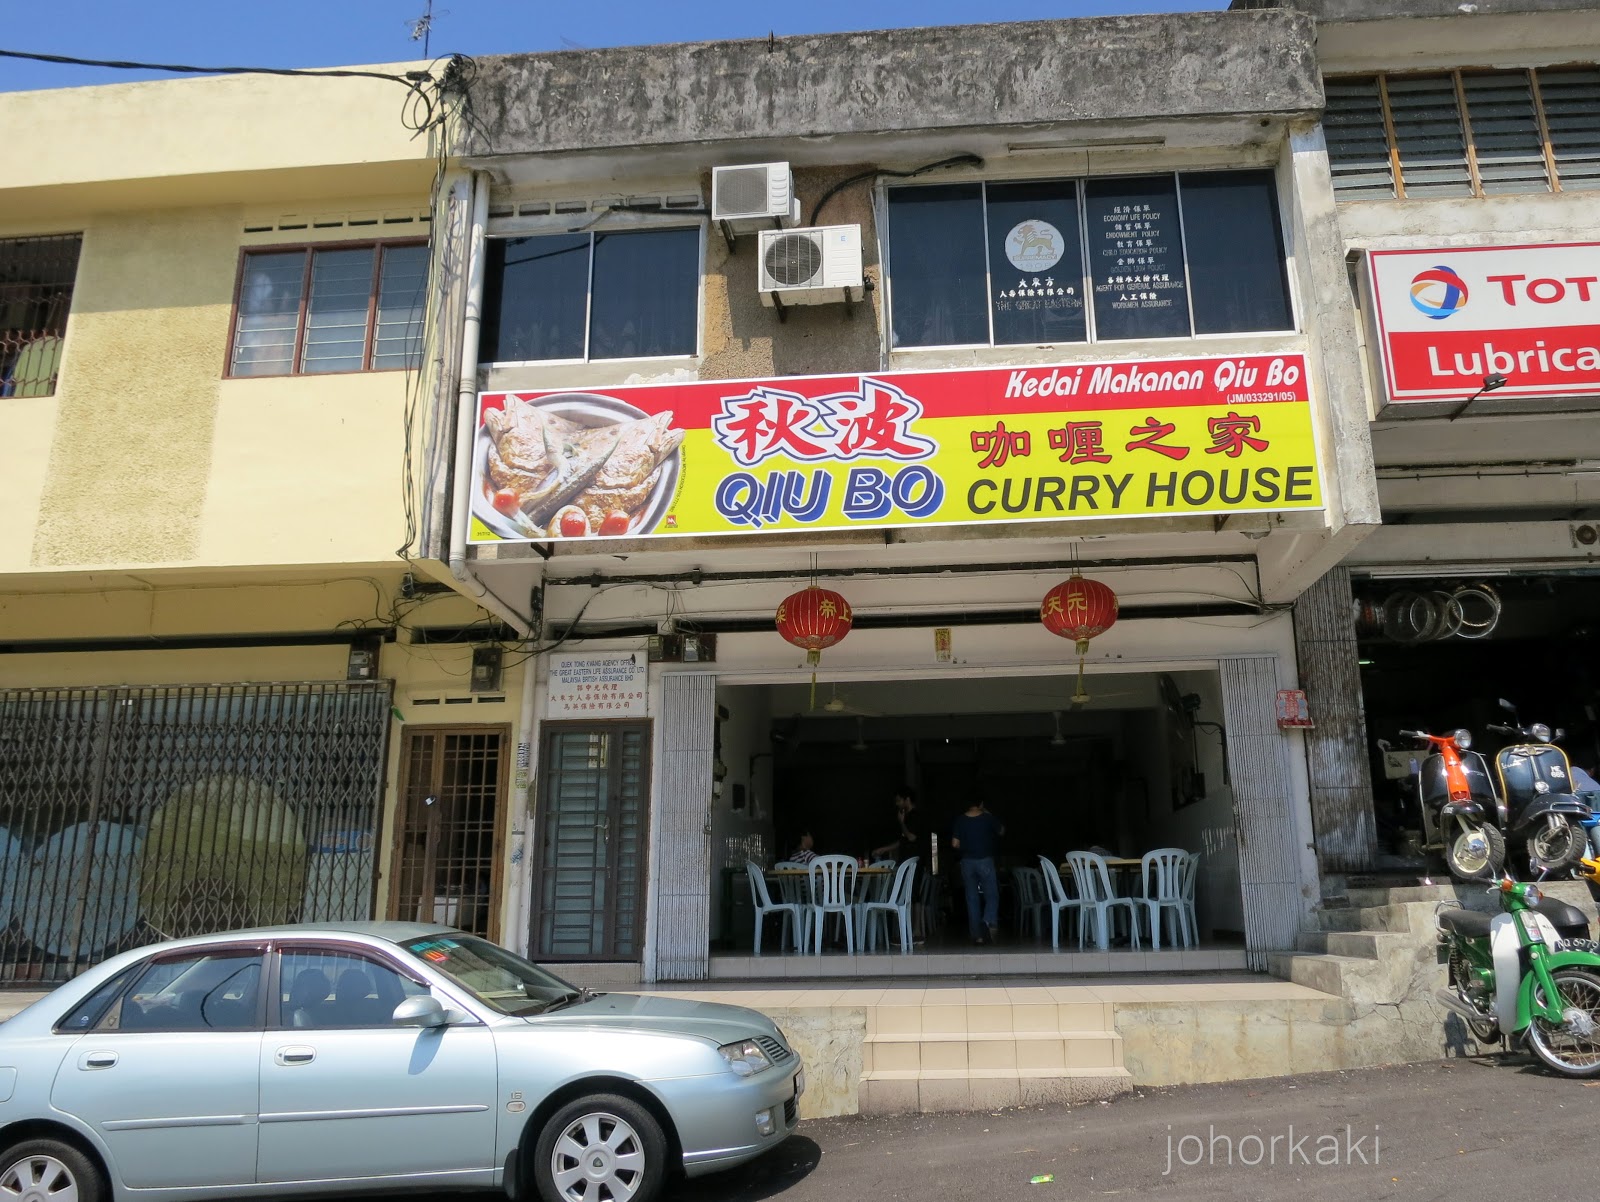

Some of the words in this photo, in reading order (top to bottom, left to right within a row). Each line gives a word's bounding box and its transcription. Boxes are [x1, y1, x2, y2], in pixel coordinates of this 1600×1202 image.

[1103, 214, 1129, 222] ECONOMY
[1129, 213, 1140, 221] LIFE
[1142, 212, 1160, 220] POLICY
[1105, 231, 1138, 239] ENDOWMENT
[1141, 230, 1160, 238] POLICY
[1096, 284, 1113, 292] AGENT
[1127, 283, 1151, 291] GENERAL
[1152, 281, 1184, 290] ASSURANCE
[1111, 301, 1139, 309] WORKMEN
[1141, 299, 1173, 308] ASSURANCE
[1004, 367, 1081, 398] Kedai
[1086, 362, 1205, 395] Makanan
[1213, 360, 1259, 392] Qiu
[1265, 358, 1300, 387] Bo
[1226, 391, 1297, 405] (JM/033291/05)
[715, 379, 936, 466] 秋波
[969, 411, 1271, 469] 咖喱之家
[714, 469, 833, 528] QIU
[841, 464, 946, 520] BO
[967, 472, 1134, 515] CURRY
[1145, 465, 1314, 508] HOUSE
[574, 660, 585, 668] TONG
[602, 659, 619, 667] AGENCY
[573, 668, 592, 676] EASTERN
[603, 667, 627, 675] ASSURANCE
